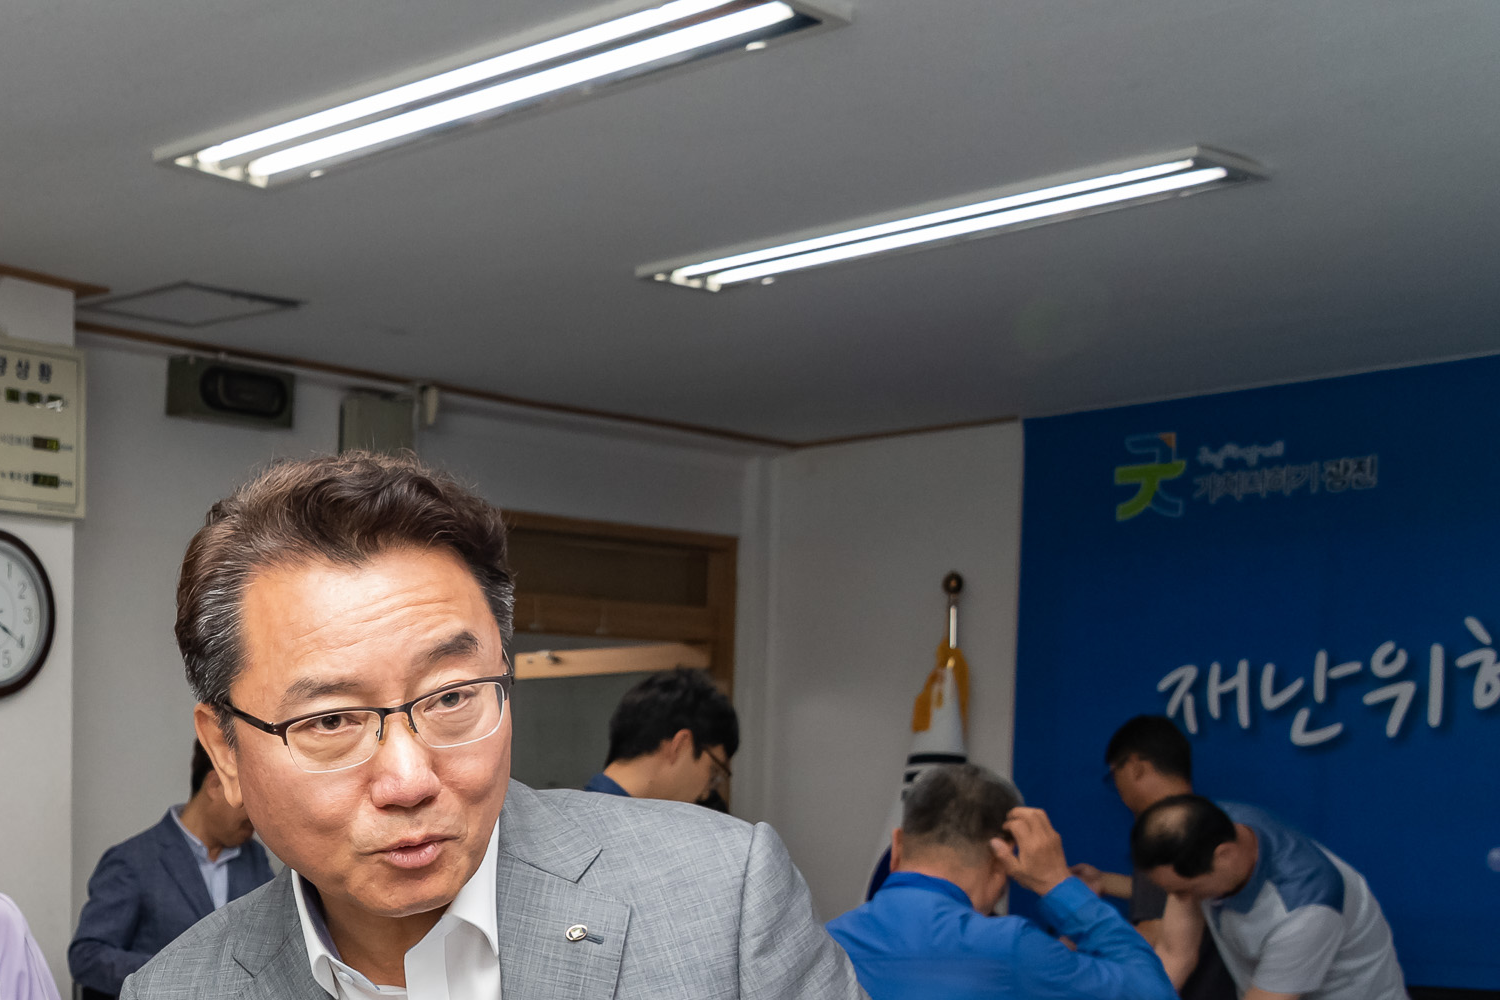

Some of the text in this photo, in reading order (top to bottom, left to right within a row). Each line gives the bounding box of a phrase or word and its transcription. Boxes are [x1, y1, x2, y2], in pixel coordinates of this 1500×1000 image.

[7, 561, 12, 579] 1
[18, 582, 28, 600] 2
[23, 606, 33, 625] 3
[2, 649, 12, 668] 5
